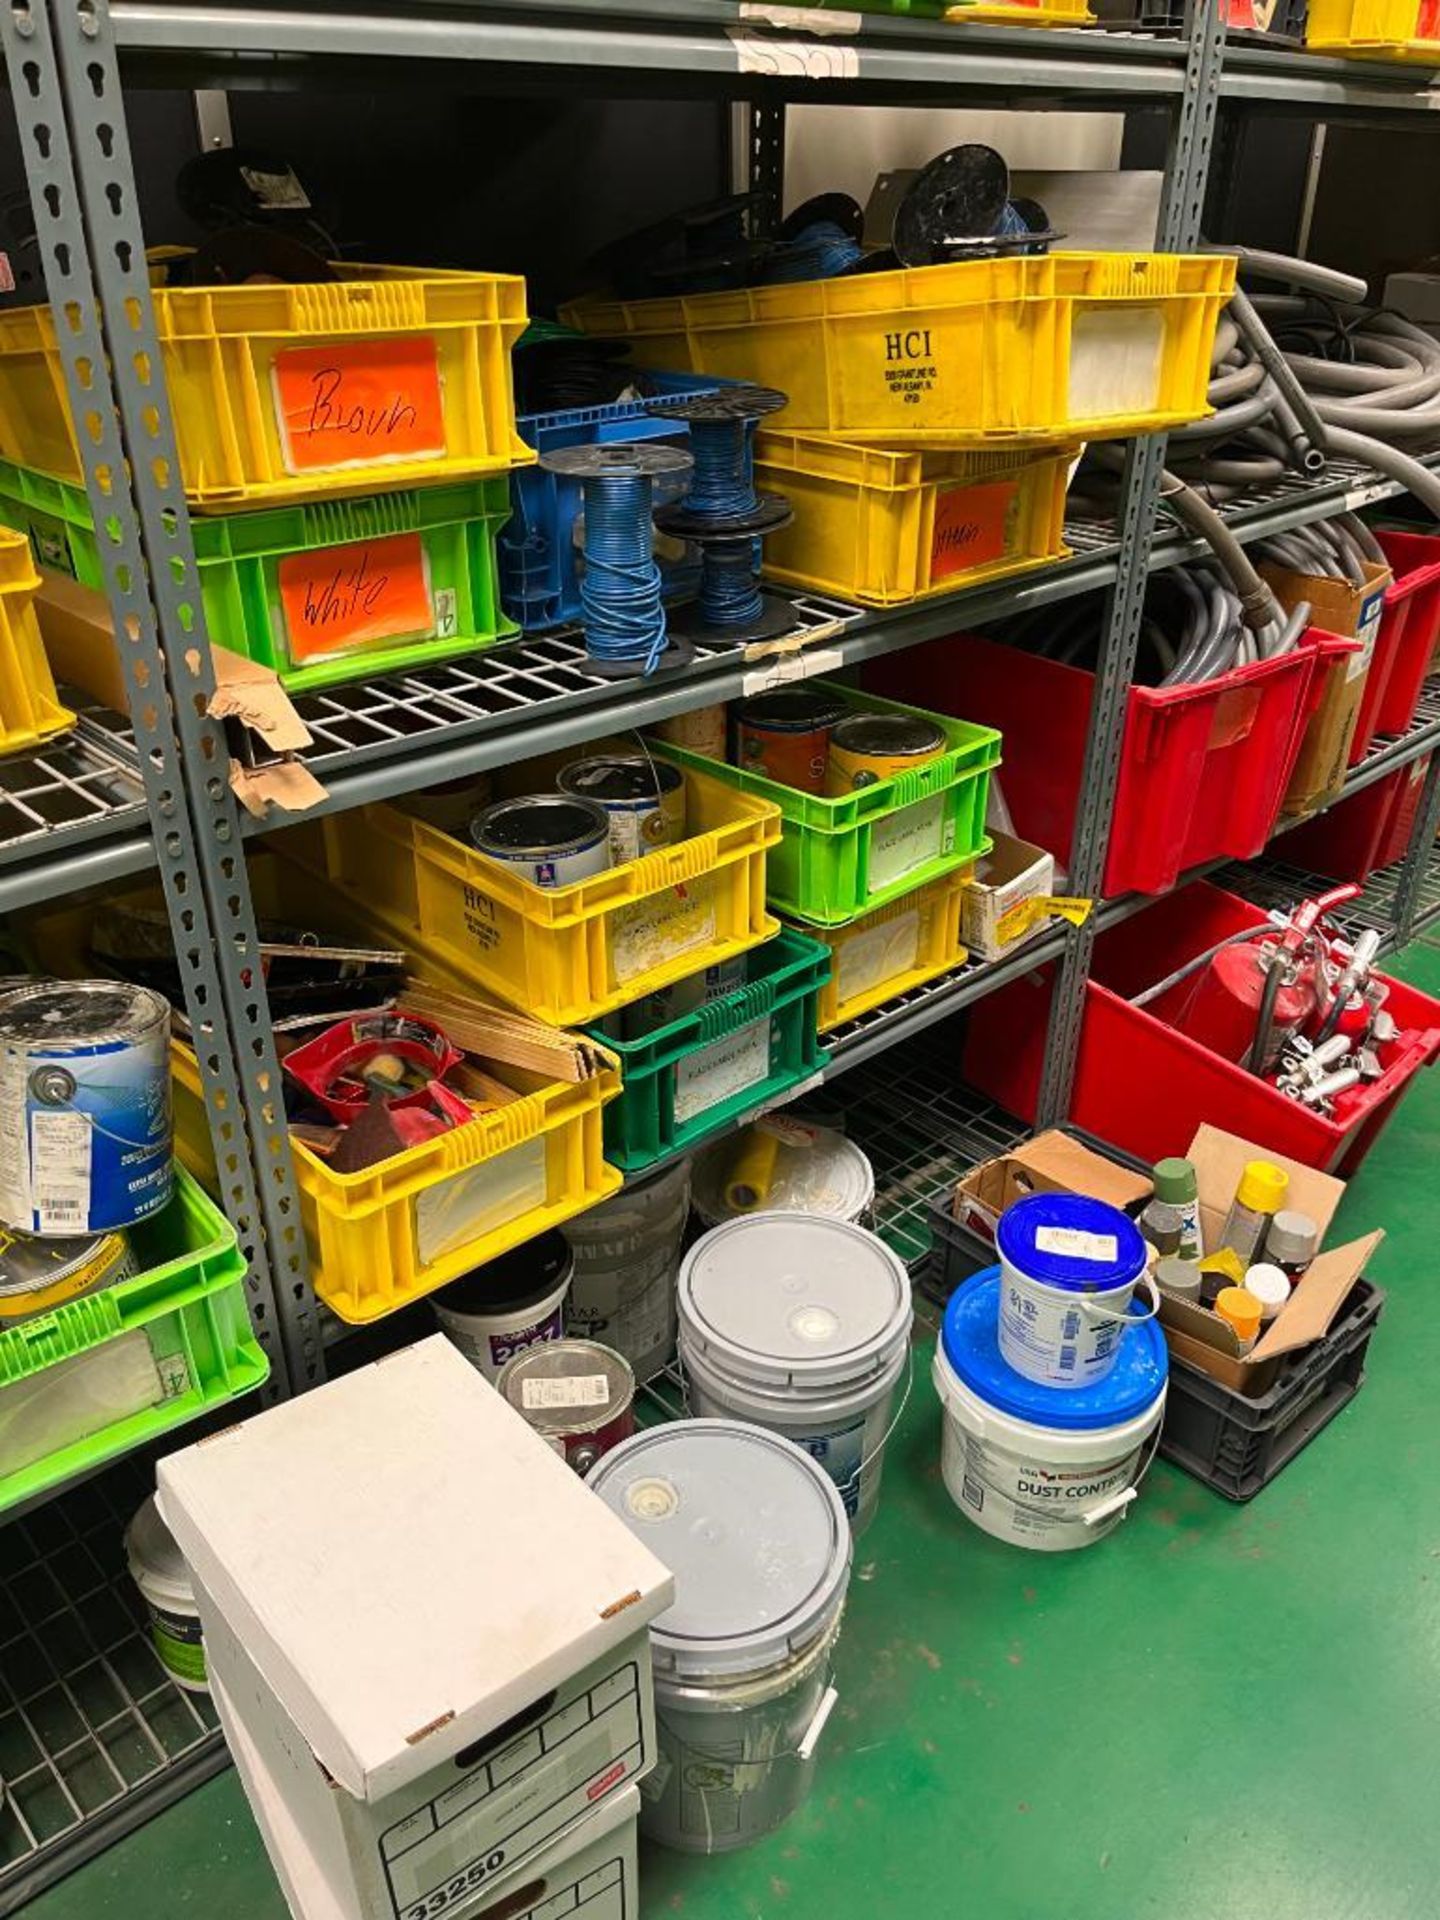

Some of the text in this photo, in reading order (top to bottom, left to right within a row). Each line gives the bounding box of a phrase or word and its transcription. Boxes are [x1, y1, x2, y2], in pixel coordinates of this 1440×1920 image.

[885, 330, 932, 361] HCI
[305, 552, 388, 626] White
[463, 886, 497, 921] HCI
[1017, 1479, 1061, 1498] DUST
[407, 1849, 505, 1920] 33250
